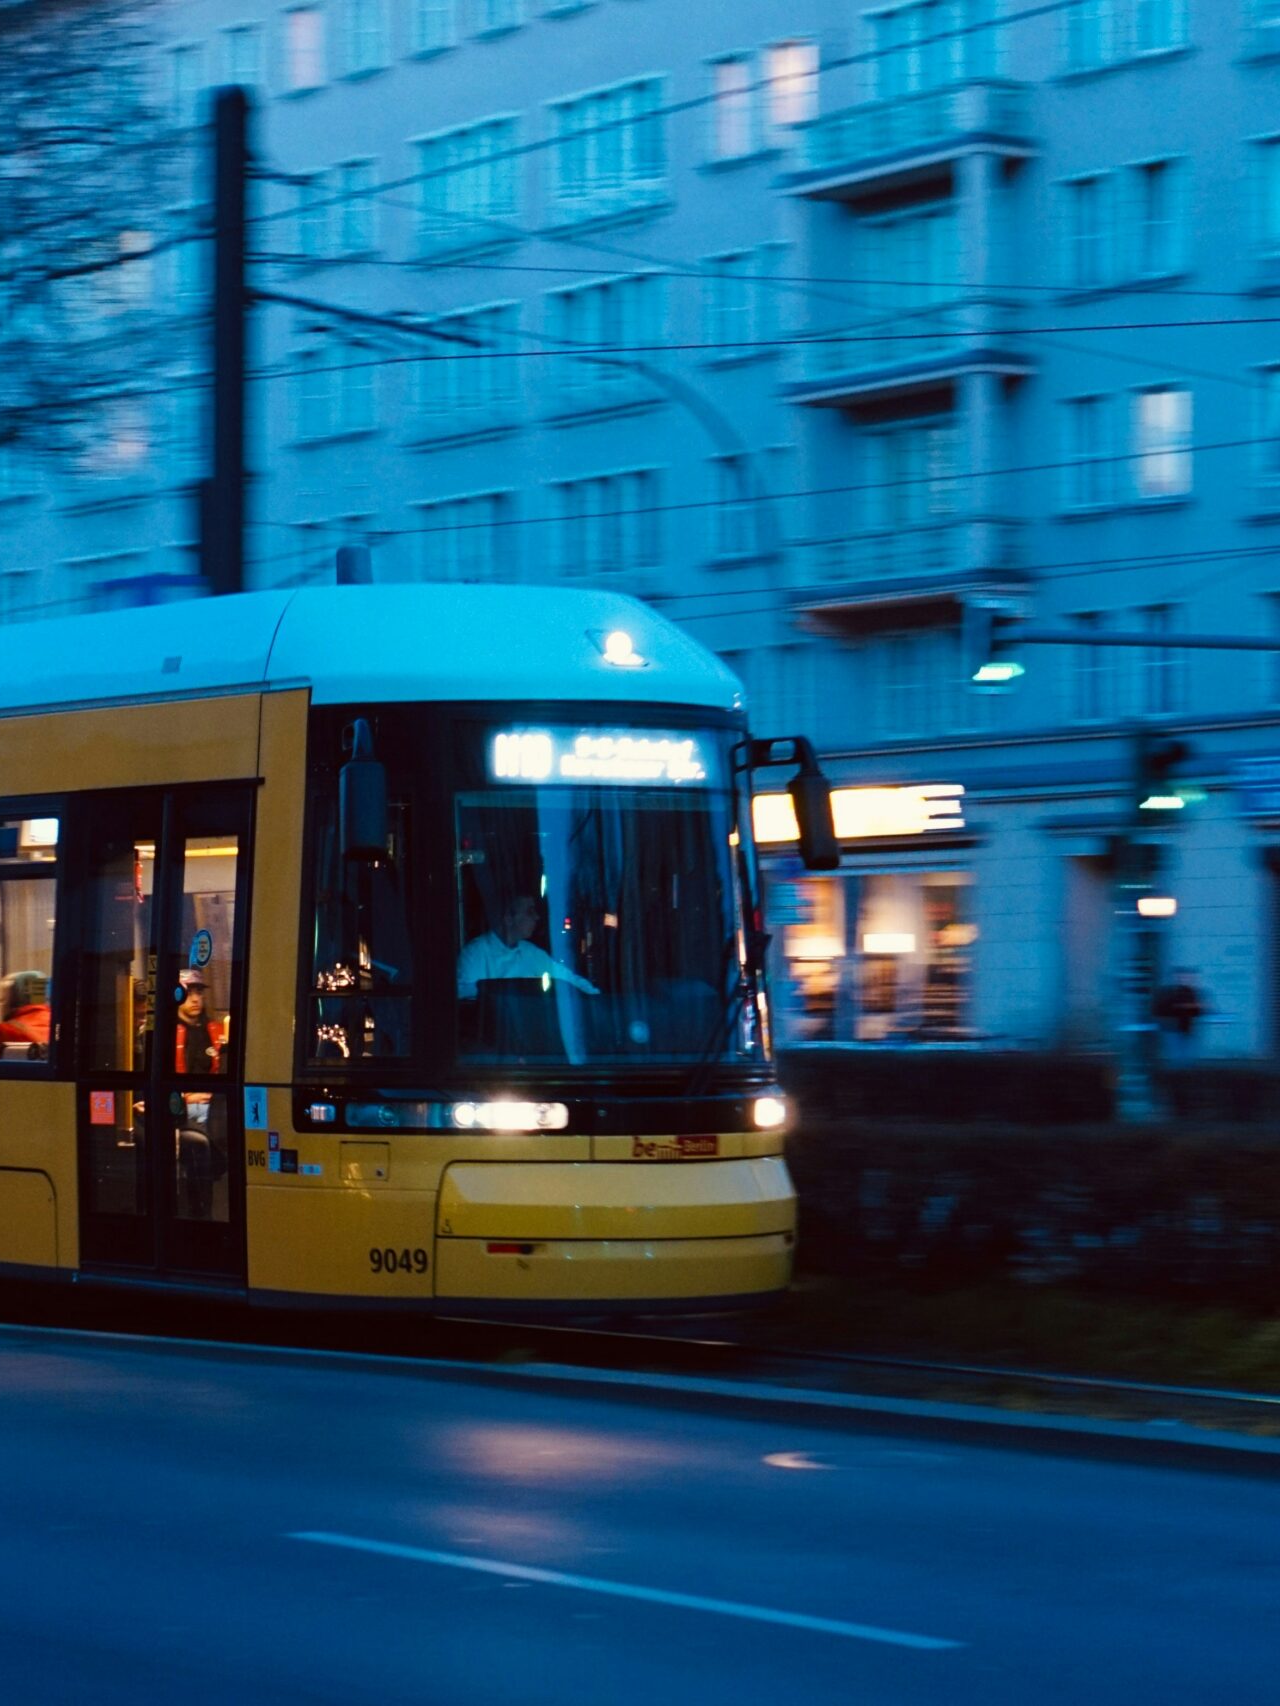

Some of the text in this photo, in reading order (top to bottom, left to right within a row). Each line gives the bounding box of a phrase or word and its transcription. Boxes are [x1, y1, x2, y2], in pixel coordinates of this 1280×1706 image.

[632, 1136, 656, 1158] be
[247, 1150, 266, 1167] BVG
[369, 1248, 428, 1274] 9049
